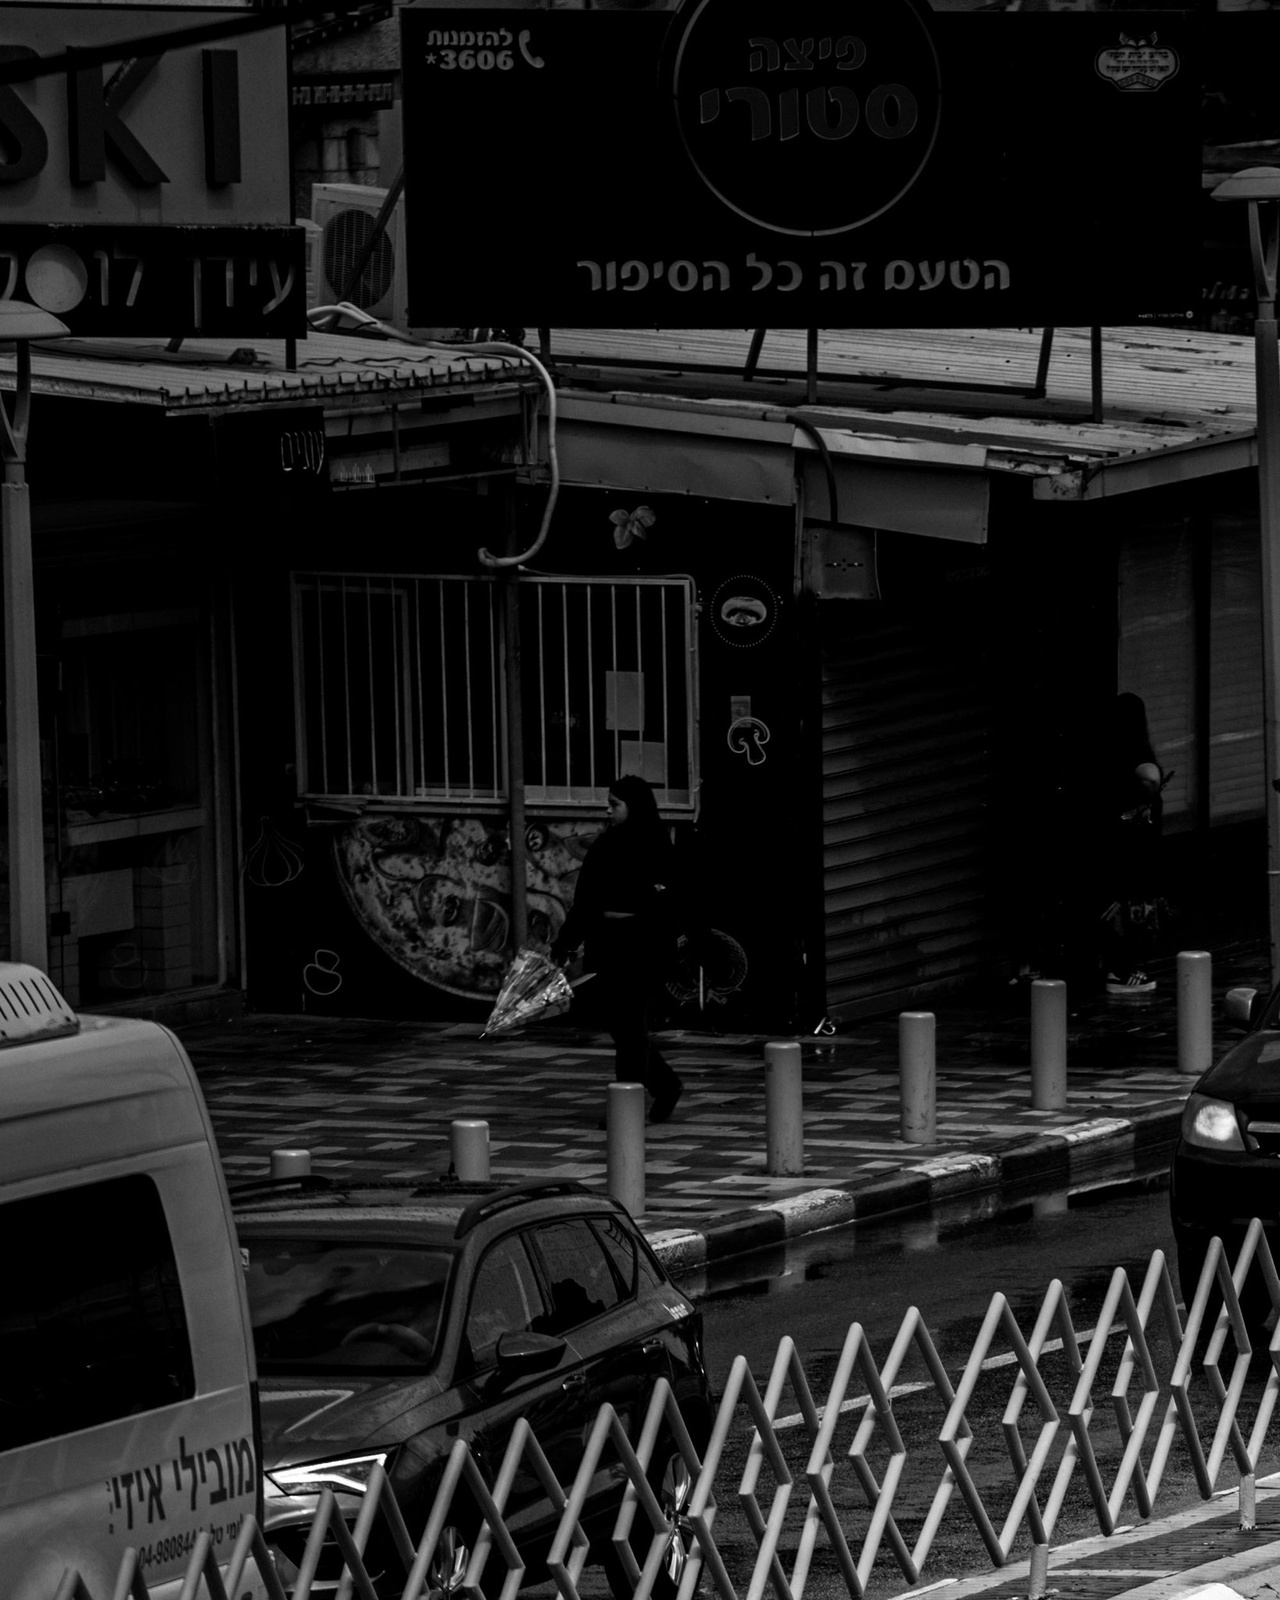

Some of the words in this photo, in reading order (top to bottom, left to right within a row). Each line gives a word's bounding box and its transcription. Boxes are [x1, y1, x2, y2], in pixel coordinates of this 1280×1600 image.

[426, 27, 514, 47] להזמנות
[748, 34, 868, 72] פיצה
[700, 82, 920, 142] סטורי
[577, 259, 731, 293] הסיפור
[745, 253, 803, 292] כל
[818, 259, 867, 292] זה
[884, 258, 1012, 292] הטעם
[173, 1436, 255, 1511] מובילי
[111, 1464, 166, 1530] איזי
